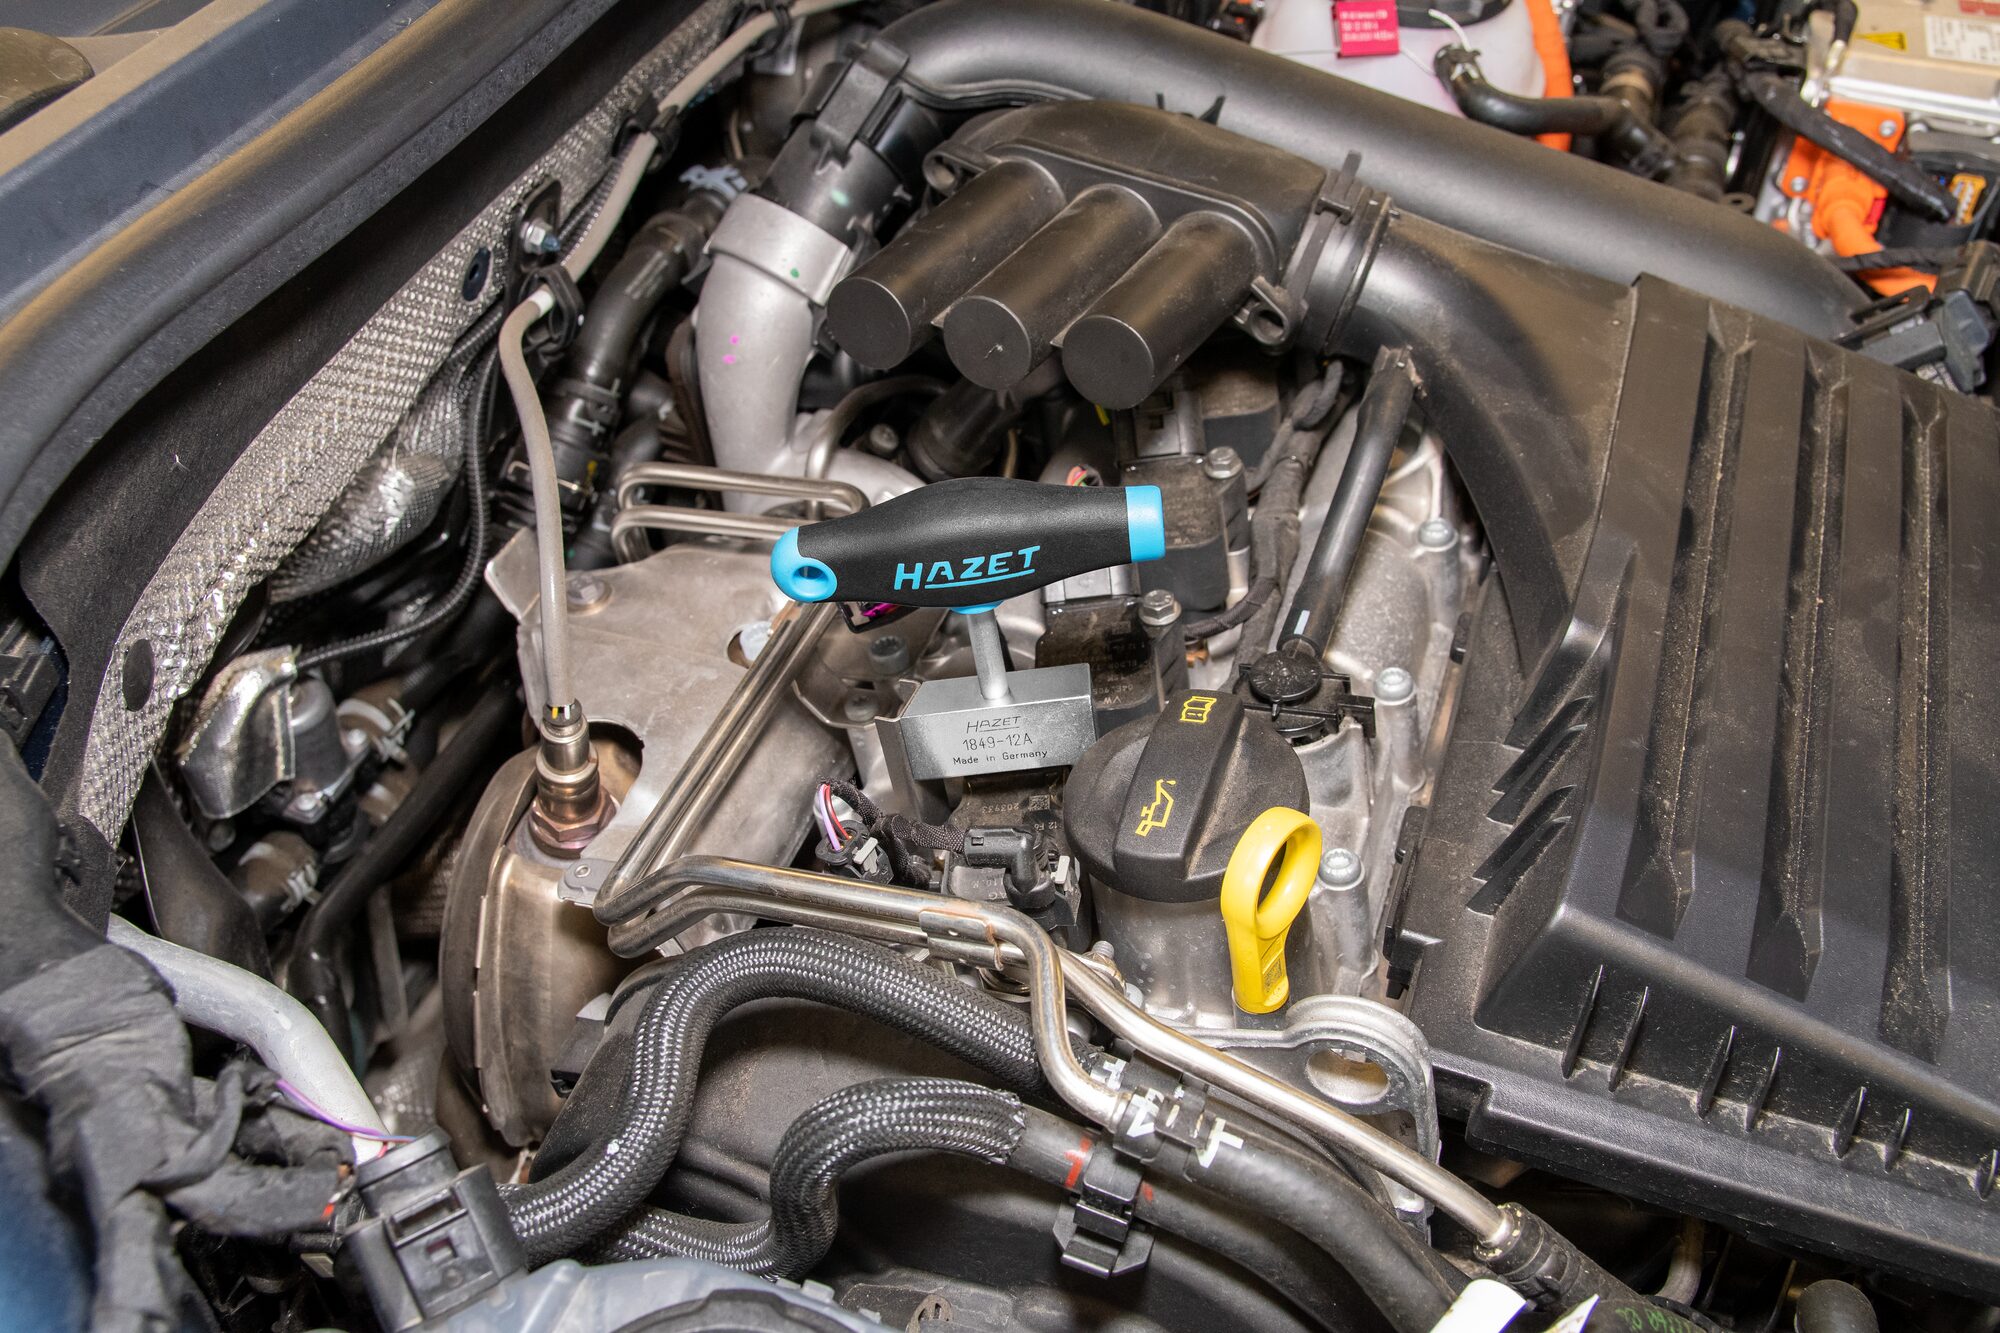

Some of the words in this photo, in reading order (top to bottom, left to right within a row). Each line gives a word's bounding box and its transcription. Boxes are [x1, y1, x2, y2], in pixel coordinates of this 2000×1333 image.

[893, 545, 1041, 591] HAZET
[1103, 696, 1122, 704] VW
[966, 715, 1022, 734] HAZET
[962, 732, 1033, 751] 1849-12A
[952, 756, 979, 765] Made
[1002, 750, 1048, 761] Germany
